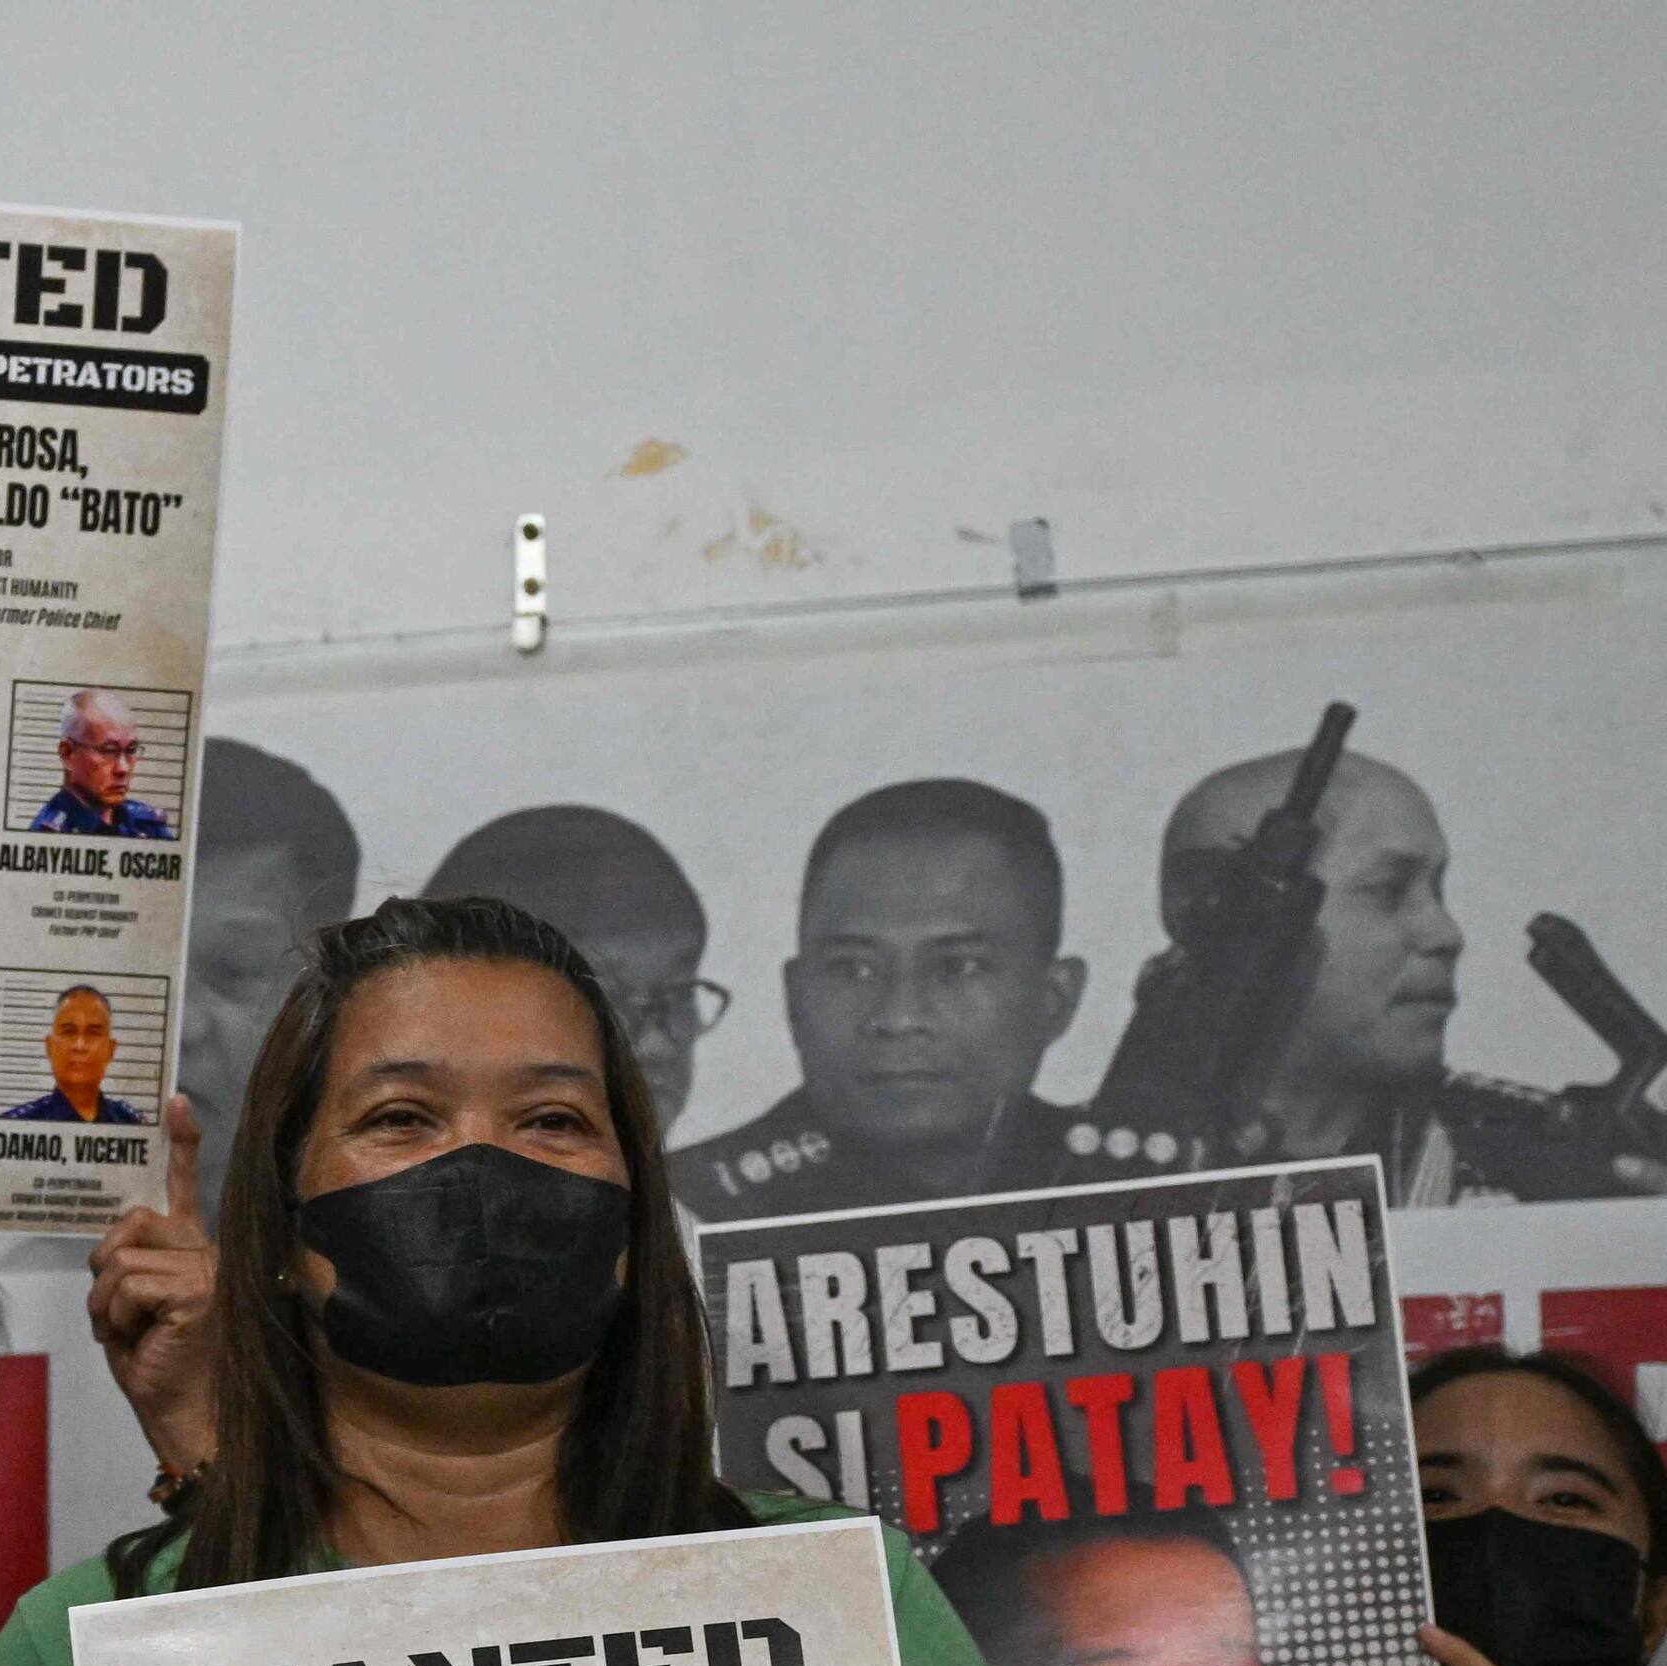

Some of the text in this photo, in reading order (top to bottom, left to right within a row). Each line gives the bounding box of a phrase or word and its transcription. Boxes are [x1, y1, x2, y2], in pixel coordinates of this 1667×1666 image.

[10, 578, 78, 600] HUMANITY
[37, 608, 80, 628] Police
[82, 611, 122, 630] Chief
[0, 844, 181, 880] ALBAYALDE, OSCAR
[75, 1137, 147, 1165] VICENTE
[726, 1200, 1374, 1386] ARESTUHIN
[897, 1354, 1361, 1531] PATAY!
